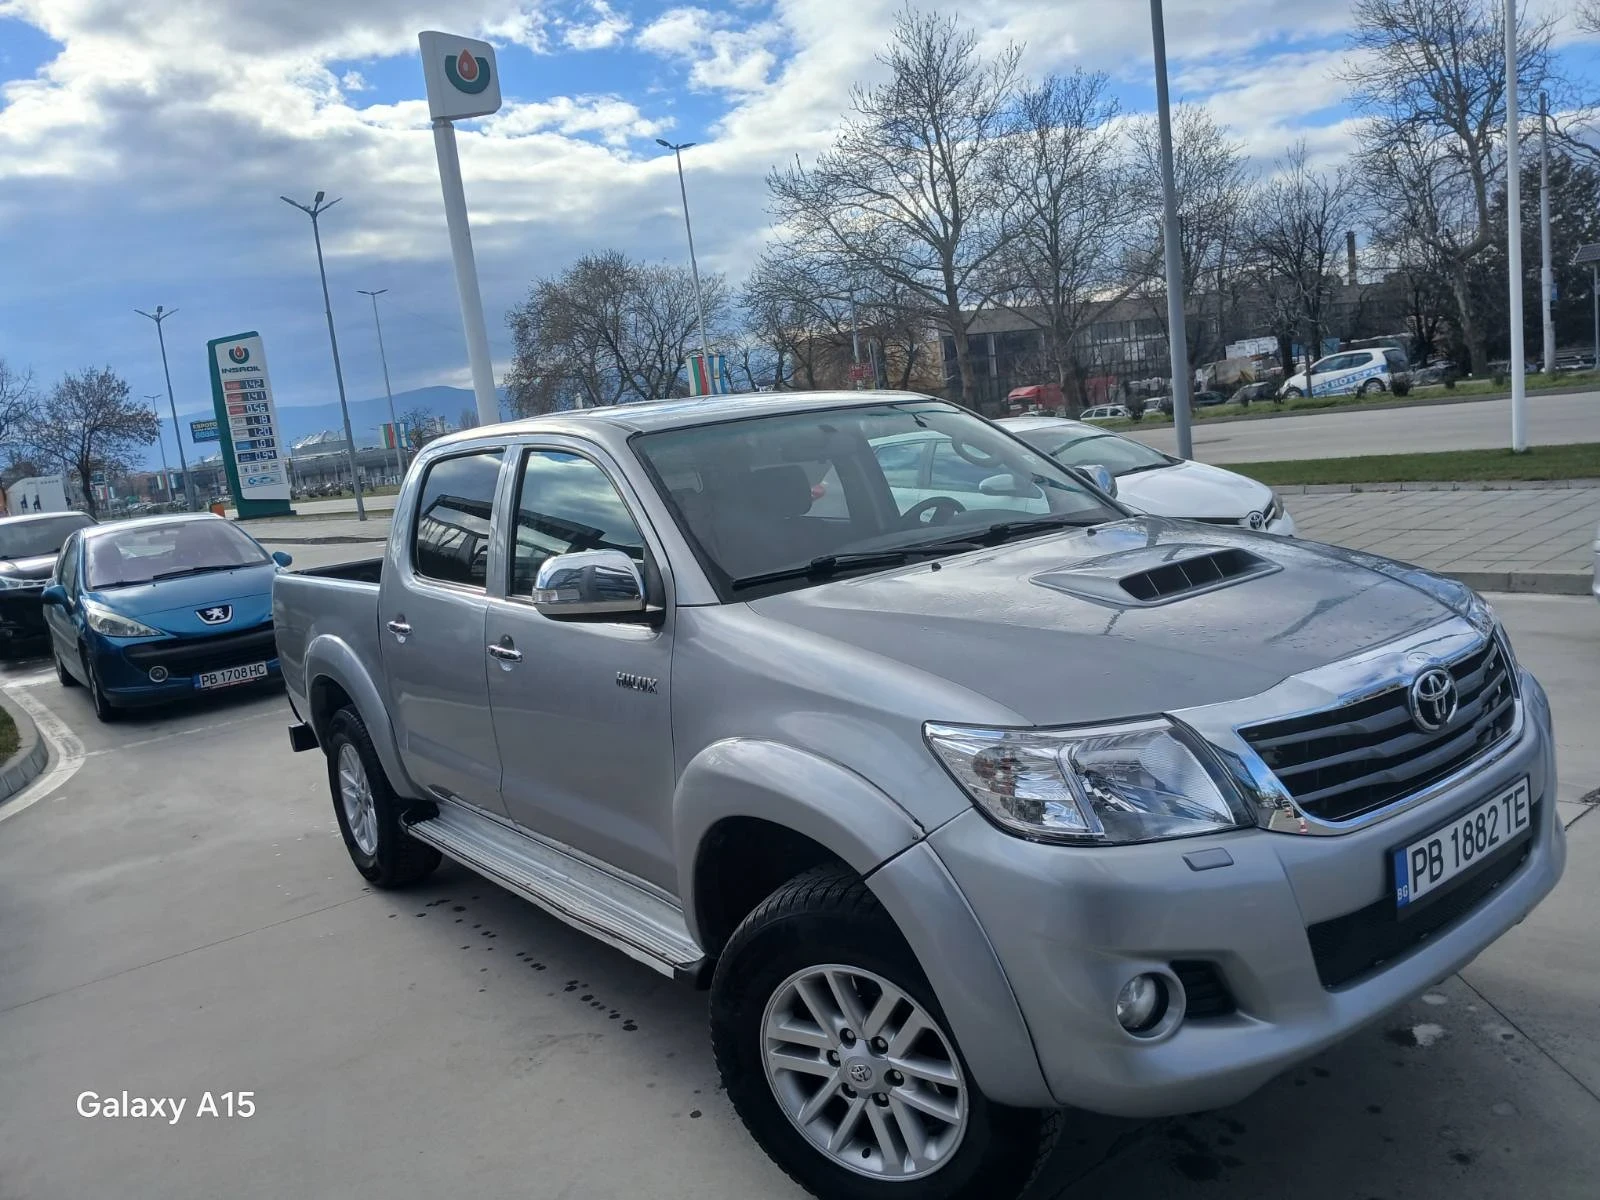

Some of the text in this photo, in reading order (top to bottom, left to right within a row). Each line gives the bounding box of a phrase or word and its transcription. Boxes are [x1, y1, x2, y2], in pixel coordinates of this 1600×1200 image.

[201, 674, 218, 686] PB
[221, 667, 248, 682] 1708
[249, 664, 265, 677] HC
[1411, 785, 1527, 894] PB 1882 TE
[1397, 884, 1408, 901] BG
